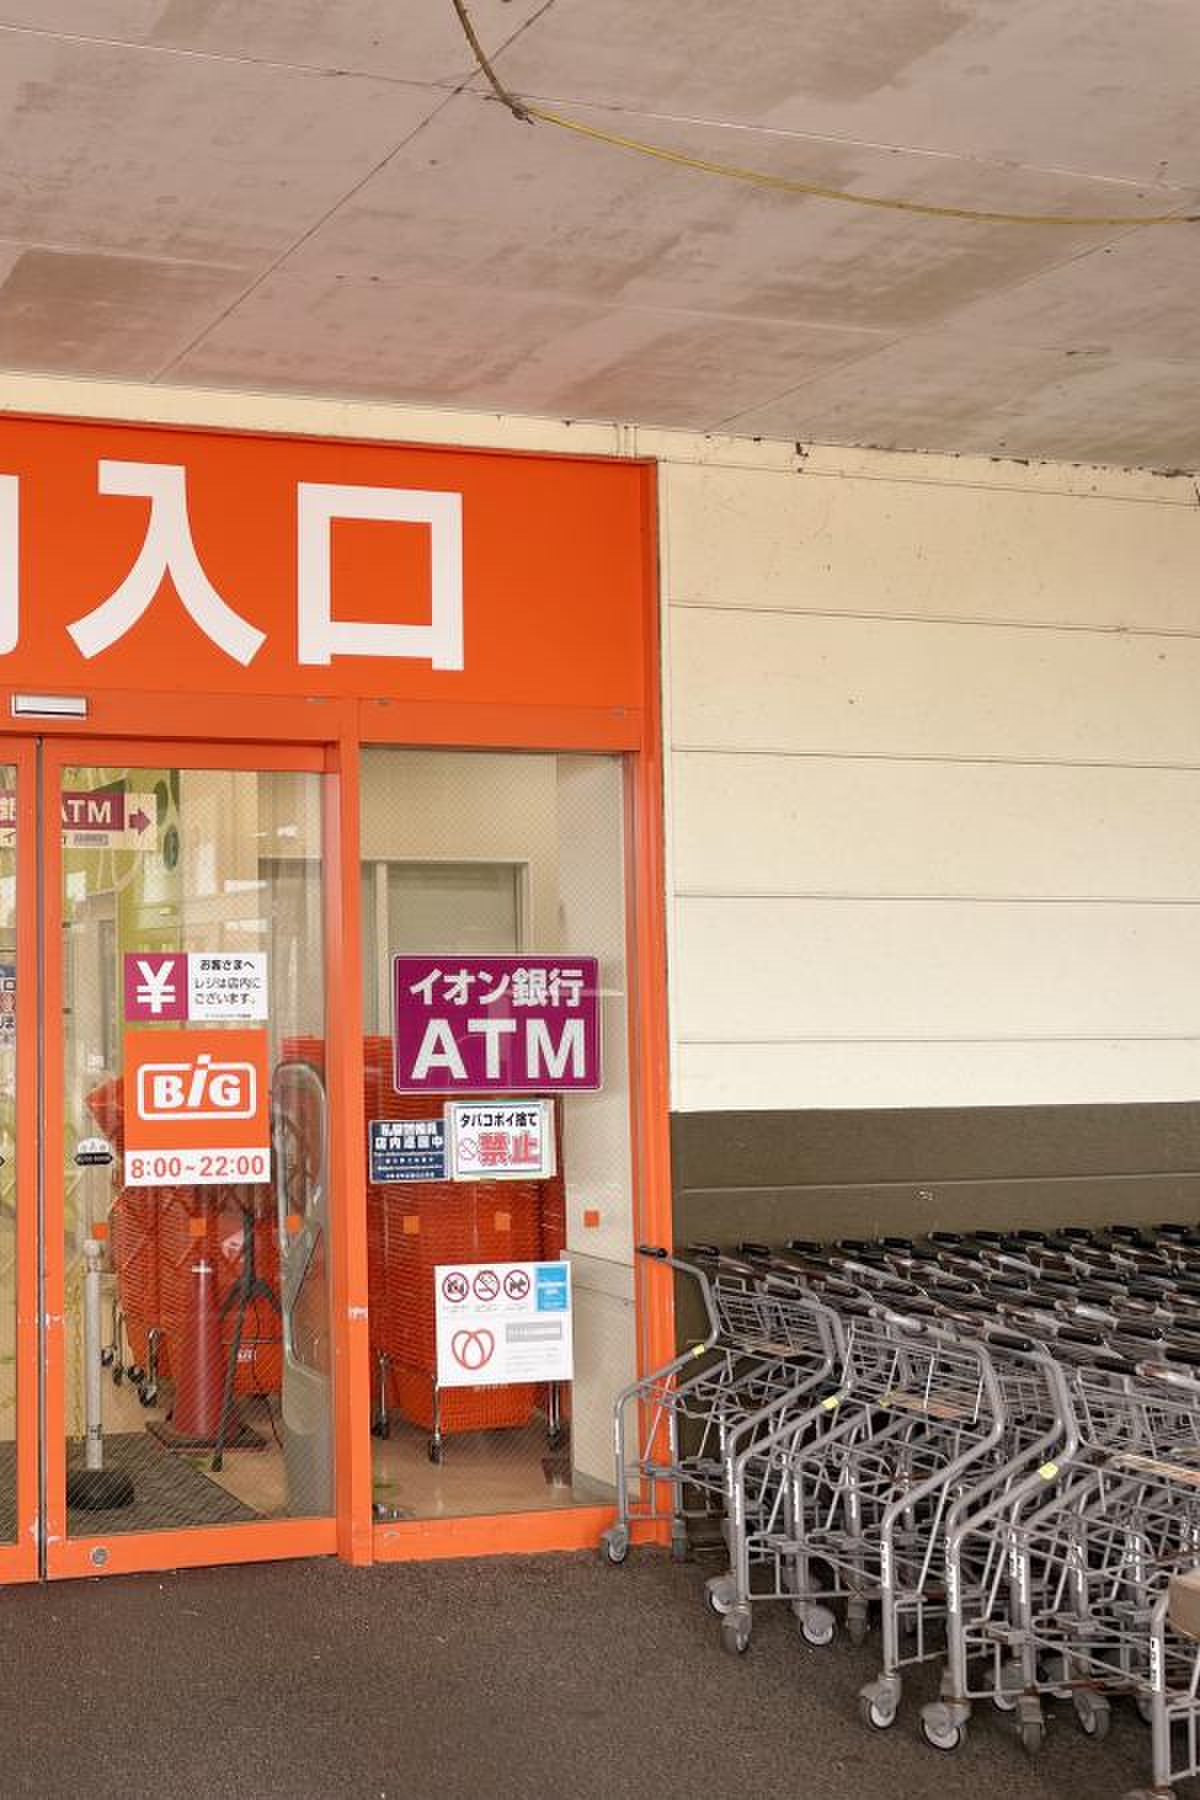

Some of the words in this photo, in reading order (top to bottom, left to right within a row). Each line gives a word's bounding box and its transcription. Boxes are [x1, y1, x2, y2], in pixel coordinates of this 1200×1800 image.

[62, 799, 112, 824] TM
[200, 959, 255, 970] お客さまへ
[194, 977, 261, 989] レジは店内に
[409, 967, 584, 1007] イオン銀行
[411, 1018, 586, 1079] ATM
[460, 1112, 538, 1128] タバコポイ捨て
[479, 1131, 539, 1167] 禁止
